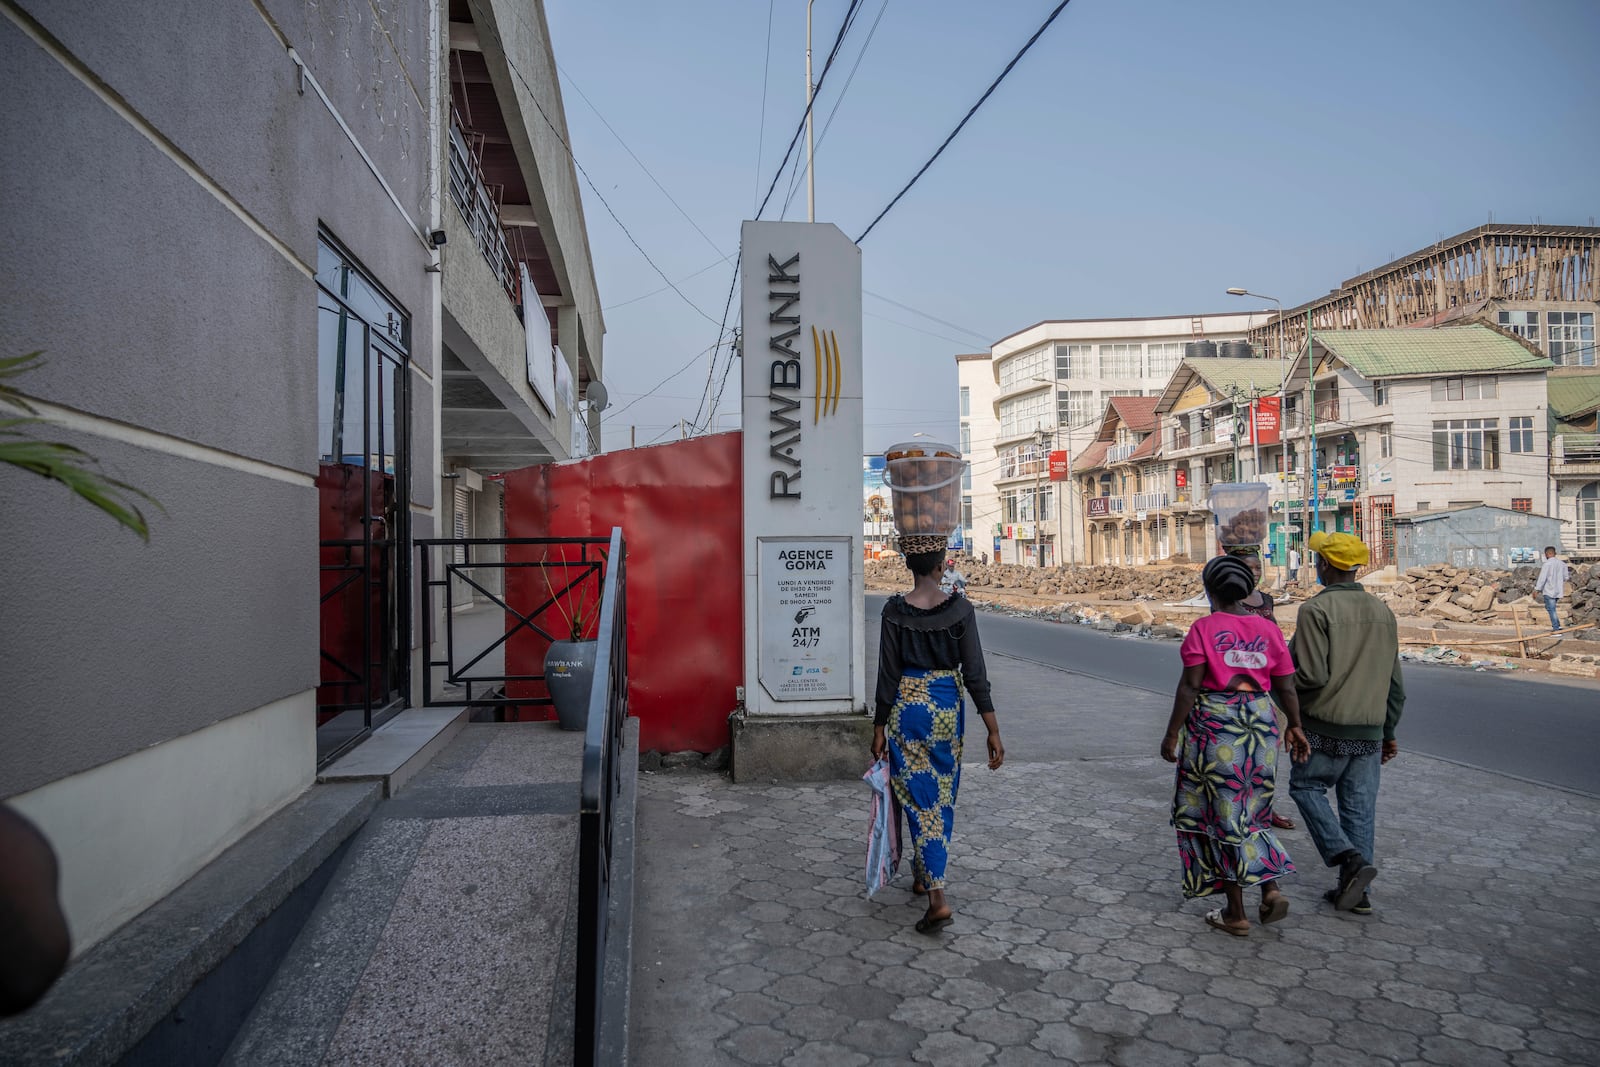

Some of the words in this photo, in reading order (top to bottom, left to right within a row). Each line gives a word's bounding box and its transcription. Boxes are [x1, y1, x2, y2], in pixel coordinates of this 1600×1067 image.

[768, 252, 801, 500] RAWBANK
[1091, 499, 1105, 510] CAA
[778, 549, 833, 561] AGENCE
[785, 560, 826, 571] GOMA
[791, 627, 820, 638] ATM
[792, 638, 820, 648] 24/7
